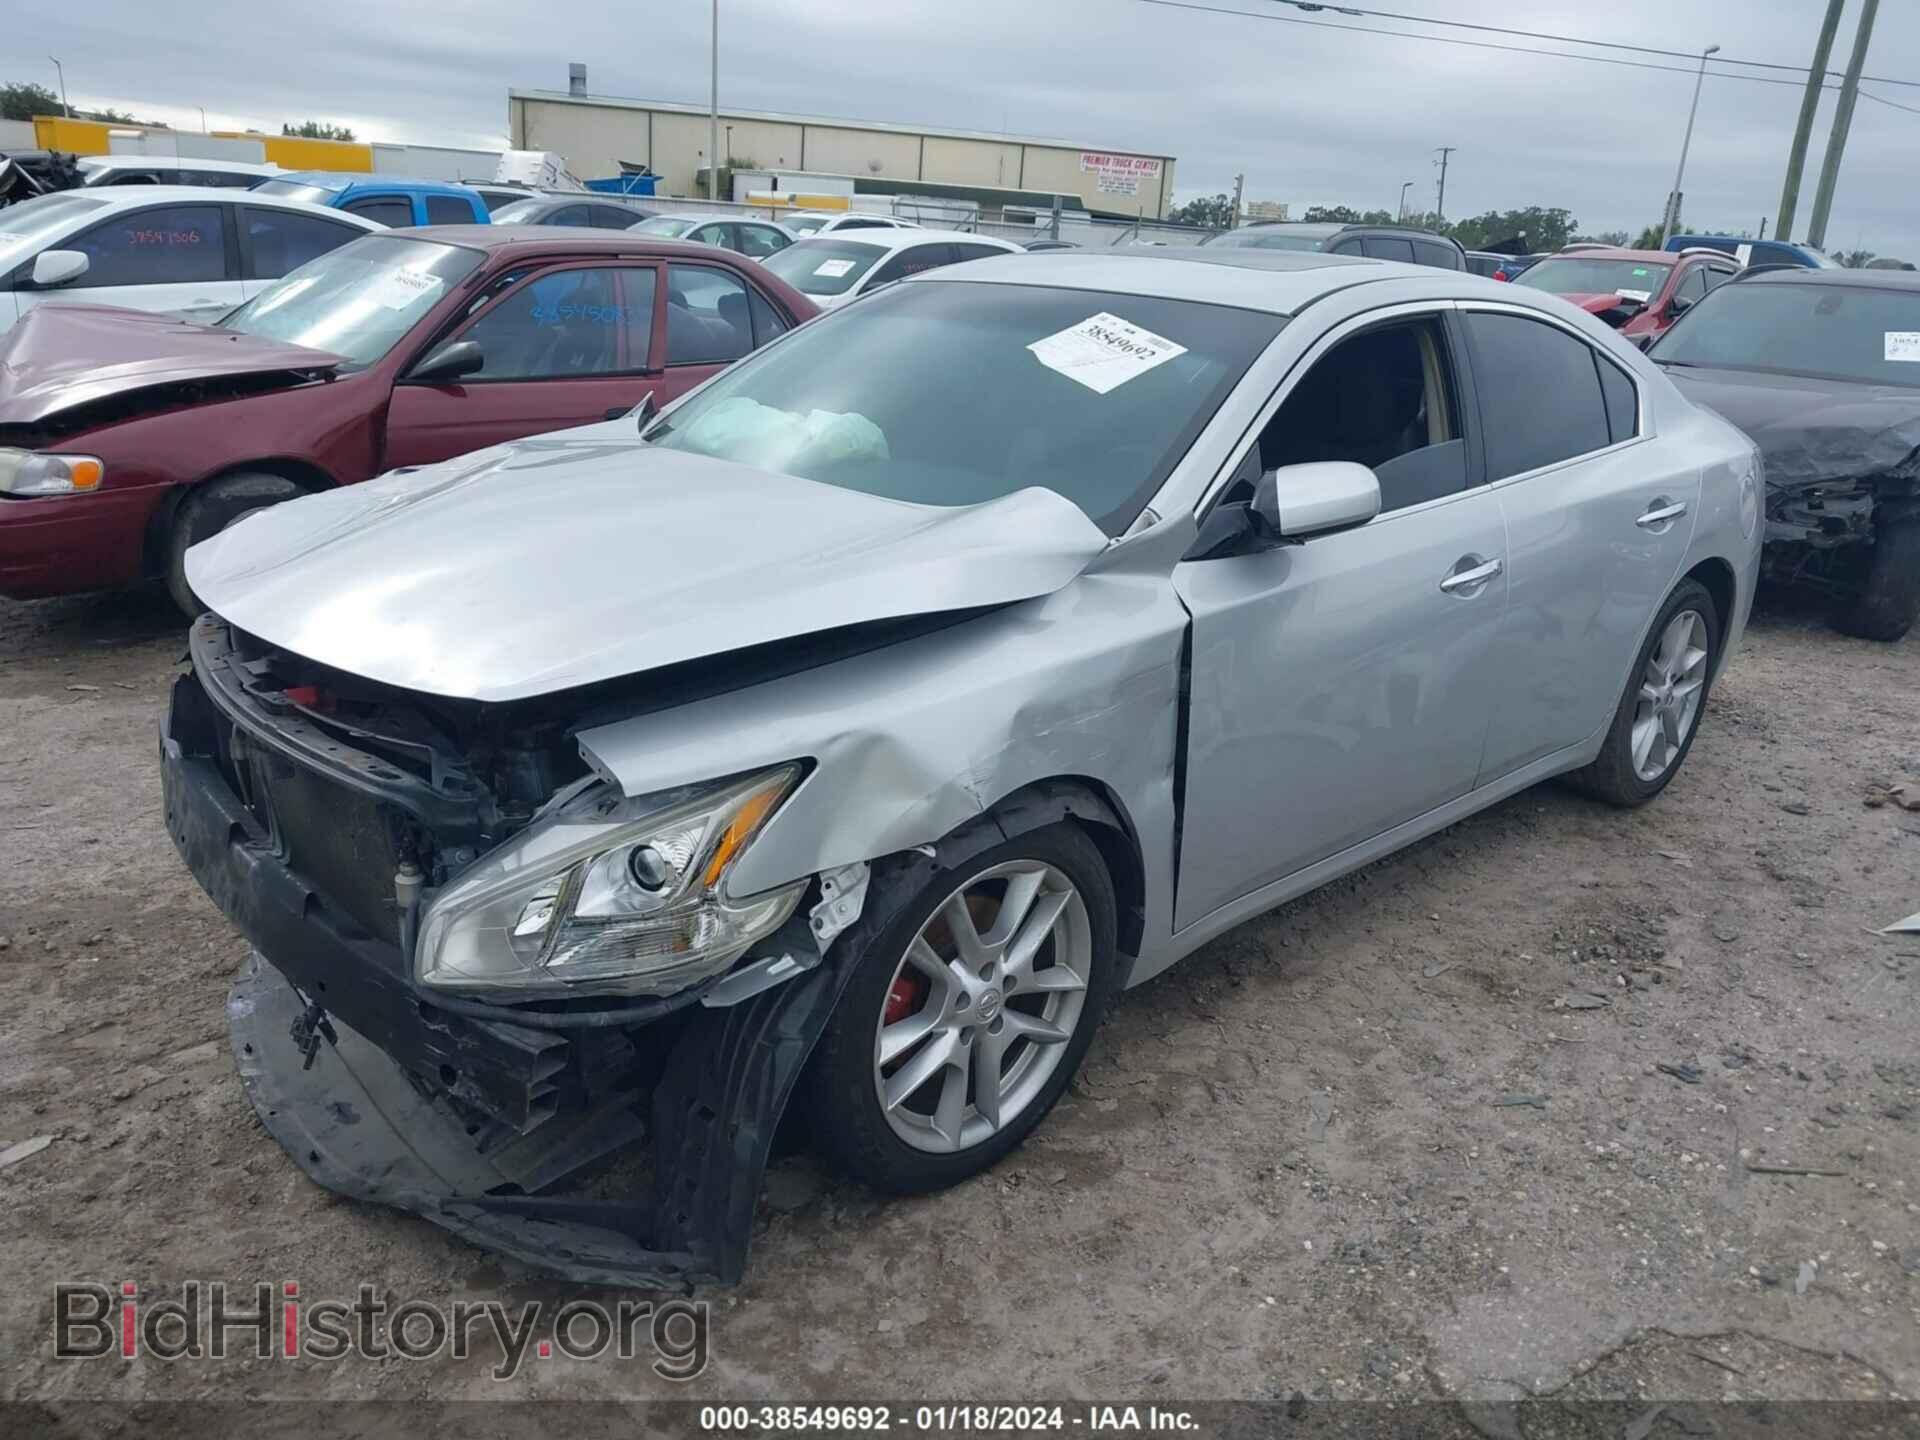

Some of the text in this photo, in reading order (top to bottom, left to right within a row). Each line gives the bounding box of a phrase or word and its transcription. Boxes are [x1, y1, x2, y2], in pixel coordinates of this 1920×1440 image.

[1083, 155, 1160, 170] PREMIER TRUCK CENTER
[1081, 324, 1156, 360] 38549692
